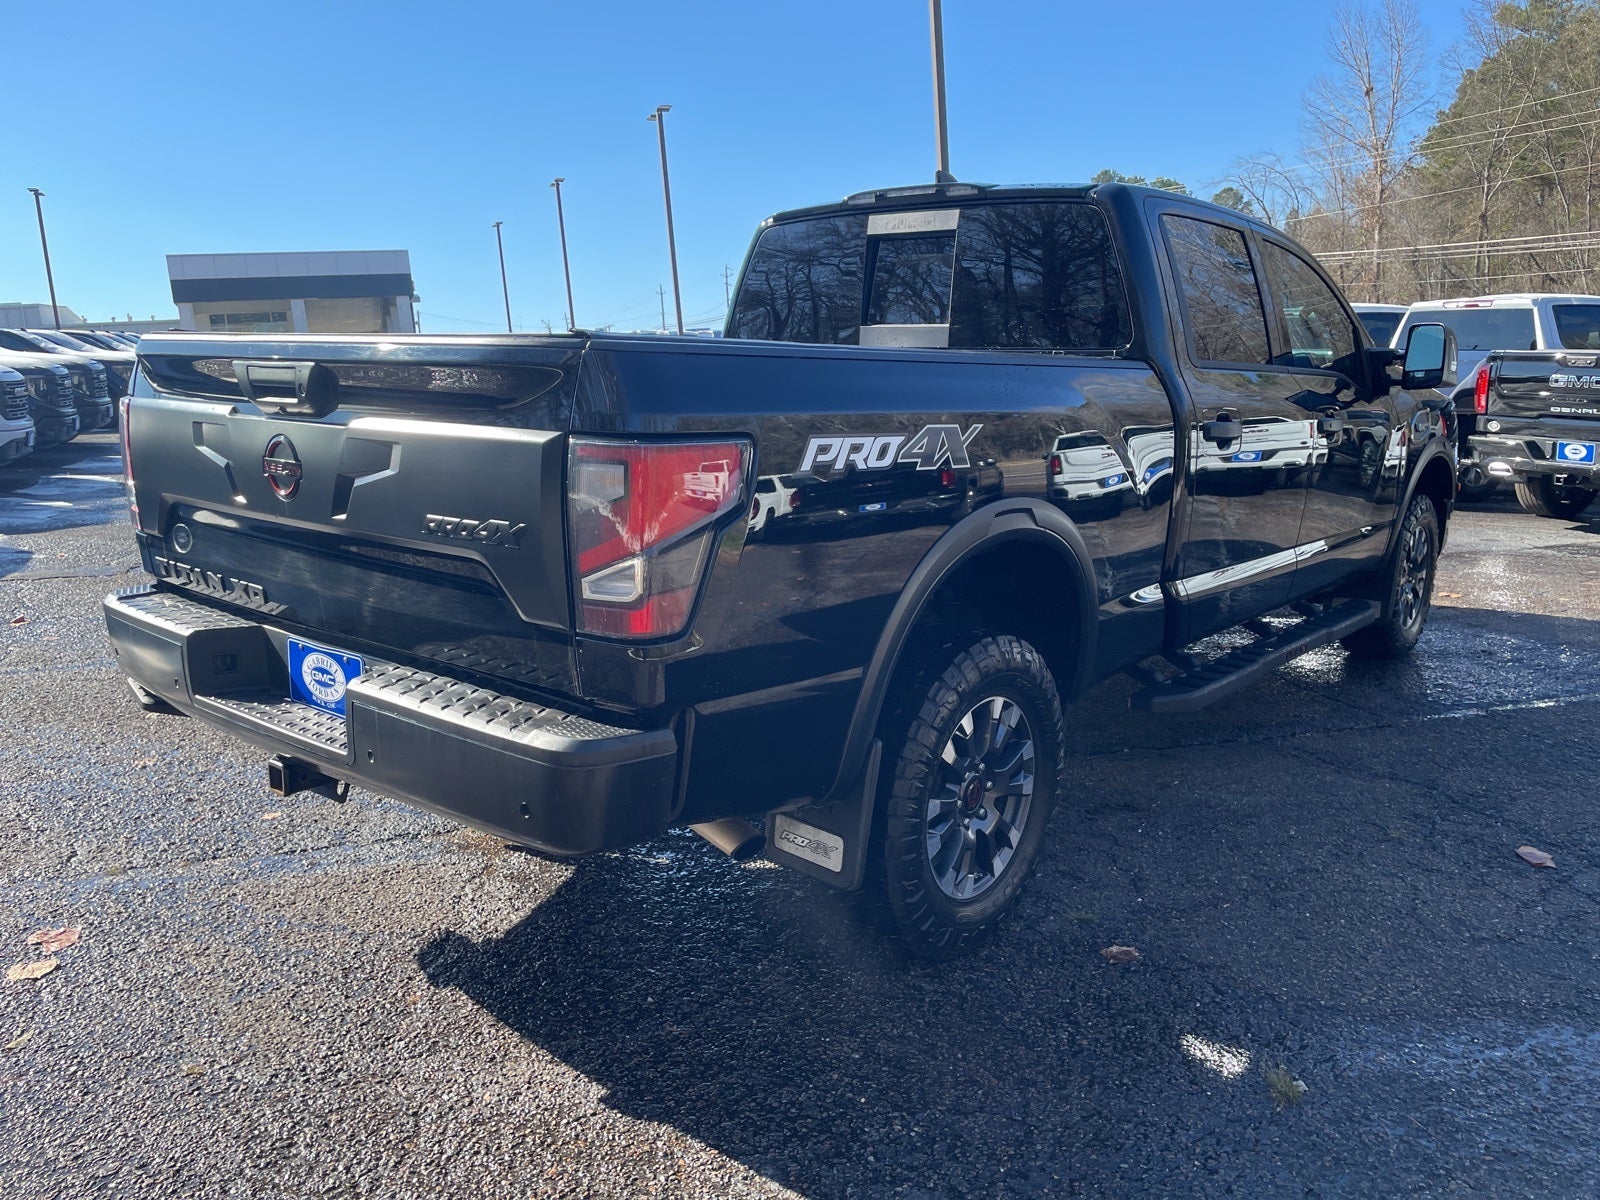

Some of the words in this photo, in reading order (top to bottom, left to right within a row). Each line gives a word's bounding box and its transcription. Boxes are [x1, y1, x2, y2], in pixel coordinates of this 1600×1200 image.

[1548, 373, 1600, 390] GMC
[799, 423, 984, 473] PRO4X
[154, 556, 227, 595] TITAN
[311, 670, 336, 685] GMC
